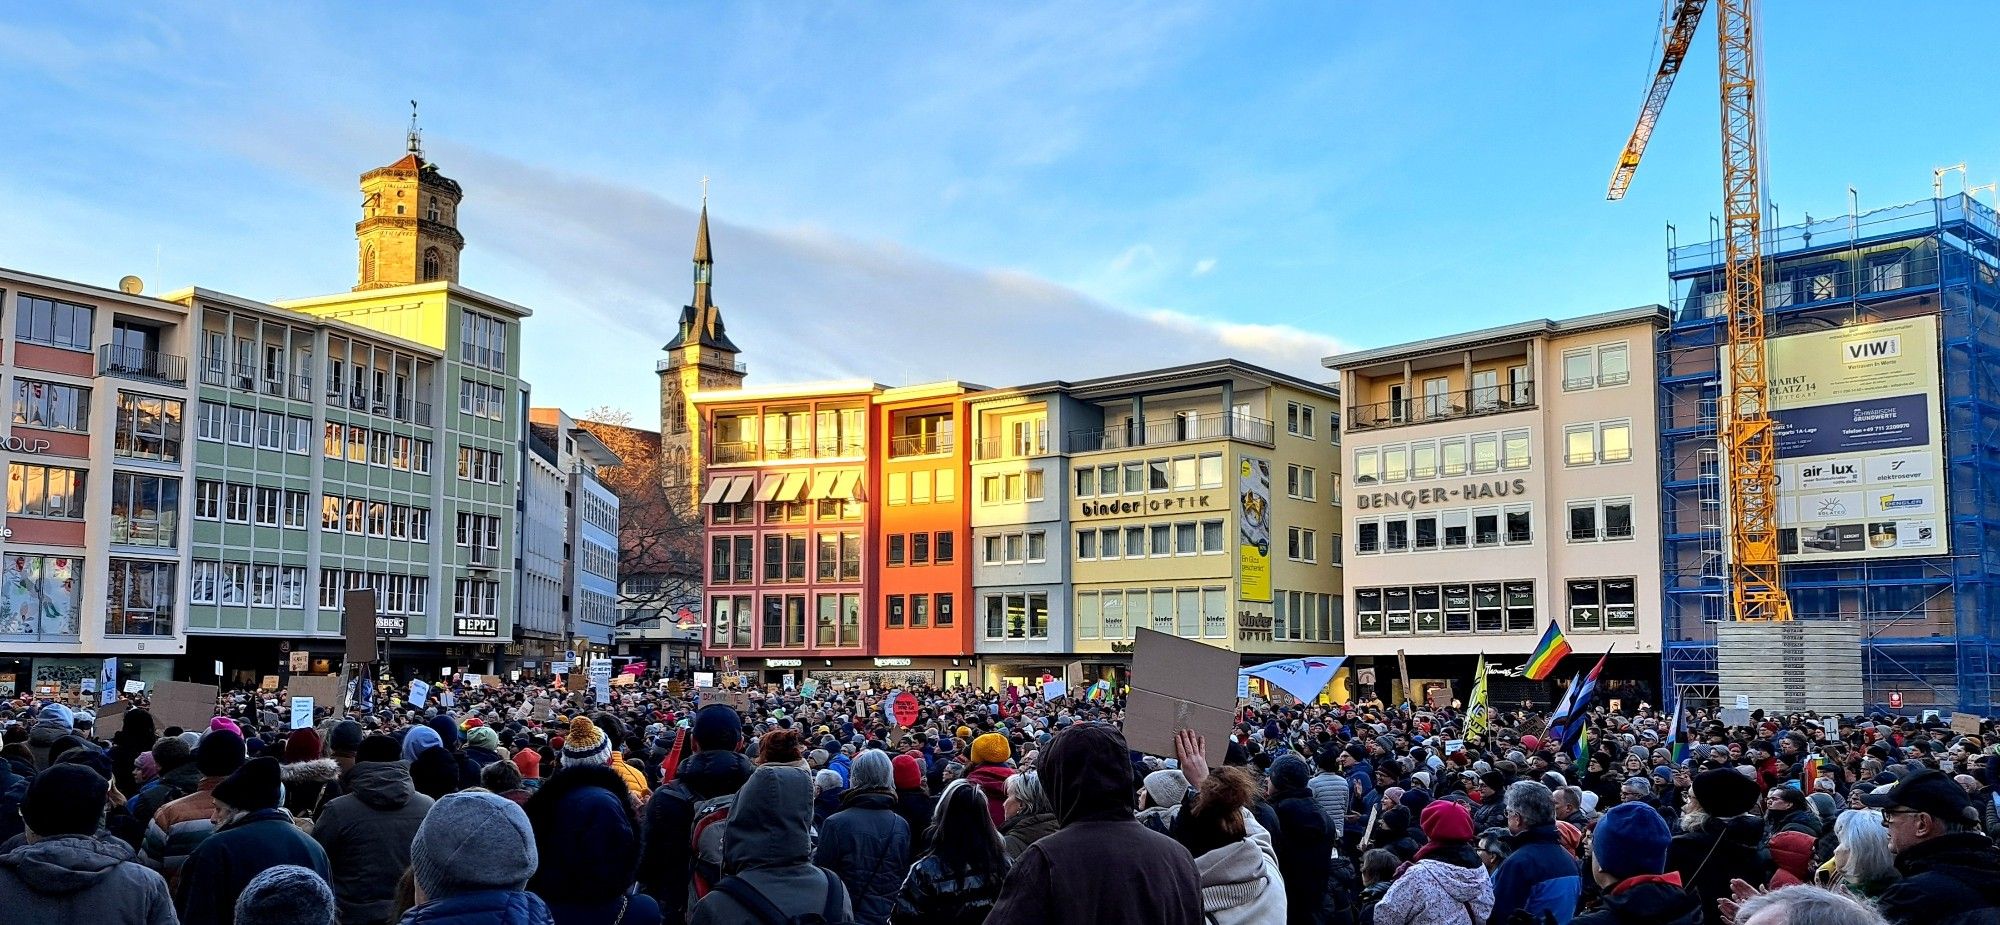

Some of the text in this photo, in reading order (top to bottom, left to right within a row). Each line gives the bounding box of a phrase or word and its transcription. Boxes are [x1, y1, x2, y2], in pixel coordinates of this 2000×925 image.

[1849, 341, 1887, 358] VIW
[1769, 376, 1806, 386] MARKT
[1769, 385, 1802, 395] PLATZ
[1854, 413, 1897, 422] GRUNDWERTE
[1877, 472, 1921, 480] elektrosever
[1356, 478, 1525, 509] BENGER-HAUS
[1082, 496, 1210, 517] binder OPTIK
[1238, 611, 1273, 628] binder
[467, 619, 496, 631] EPPLI
[1239, 632, 1273, 641] OPTIK
[1111, 641, 1135, 652] bind
[874, 658, 911, 667] NESPRESSO
